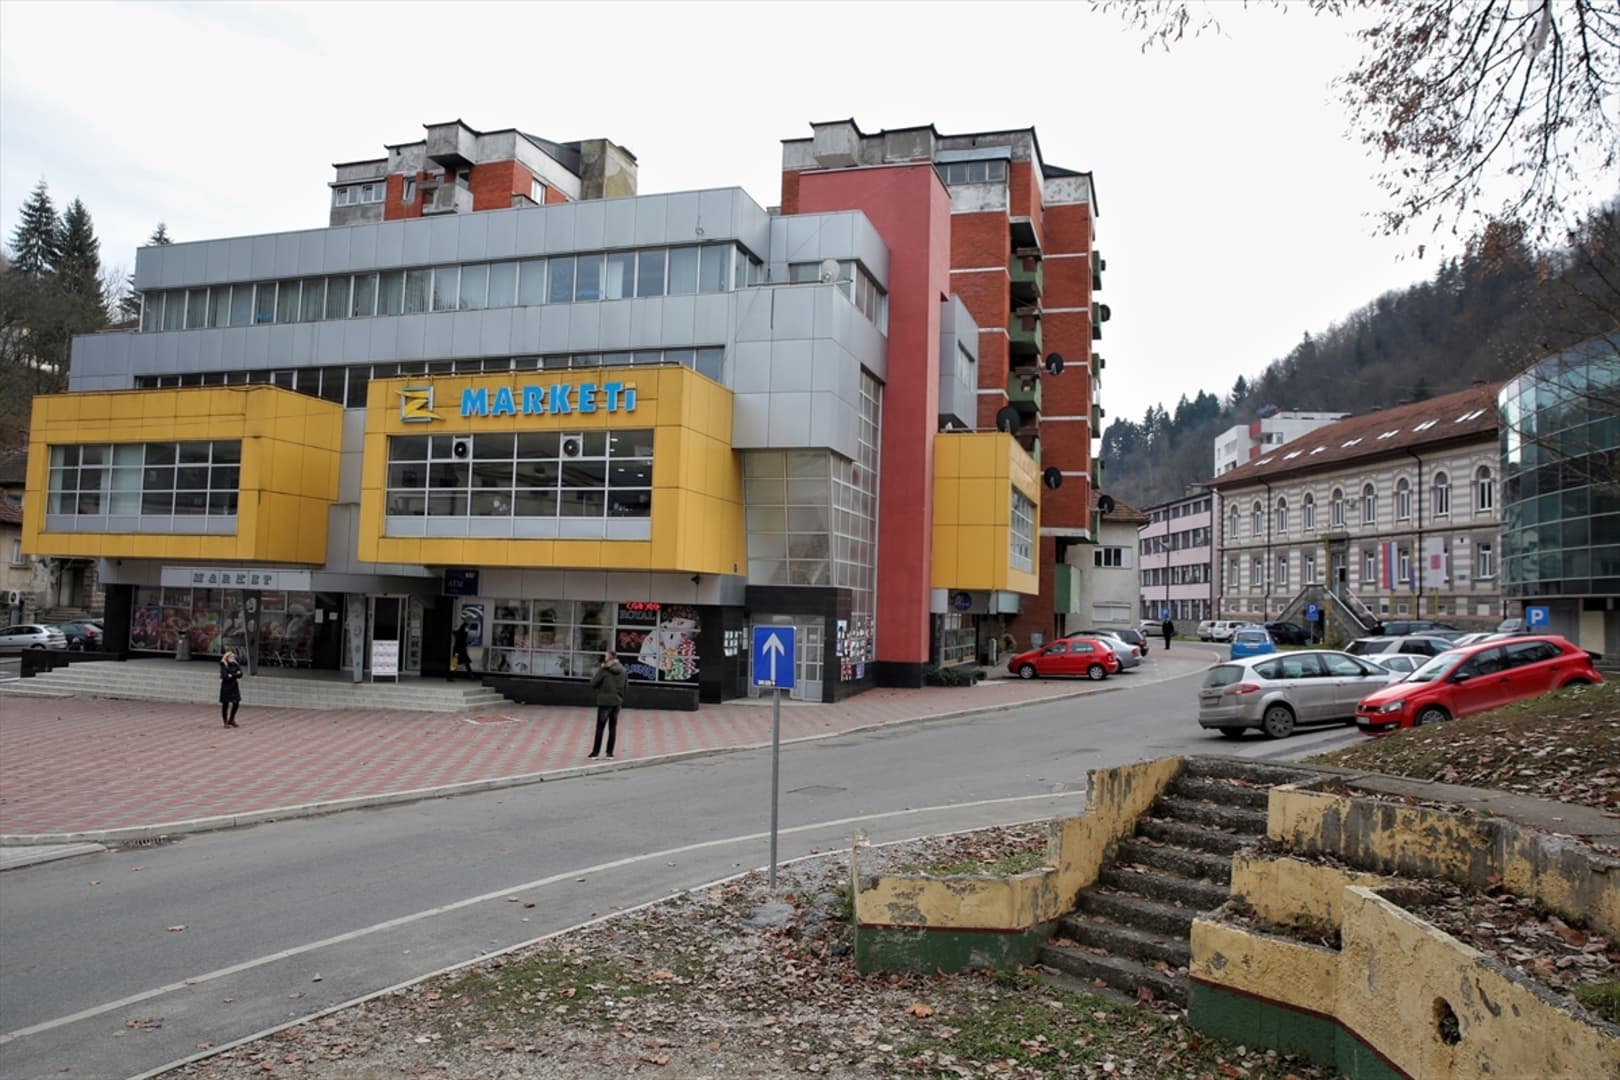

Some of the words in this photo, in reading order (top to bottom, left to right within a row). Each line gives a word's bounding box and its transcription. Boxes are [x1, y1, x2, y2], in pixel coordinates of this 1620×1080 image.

[460, 382, 637, 417] MARKETi
[192, 572, 272, 586] MARKET
[1308, 604, 1317, 614] P
[1530, 609, 1544, 625] P
